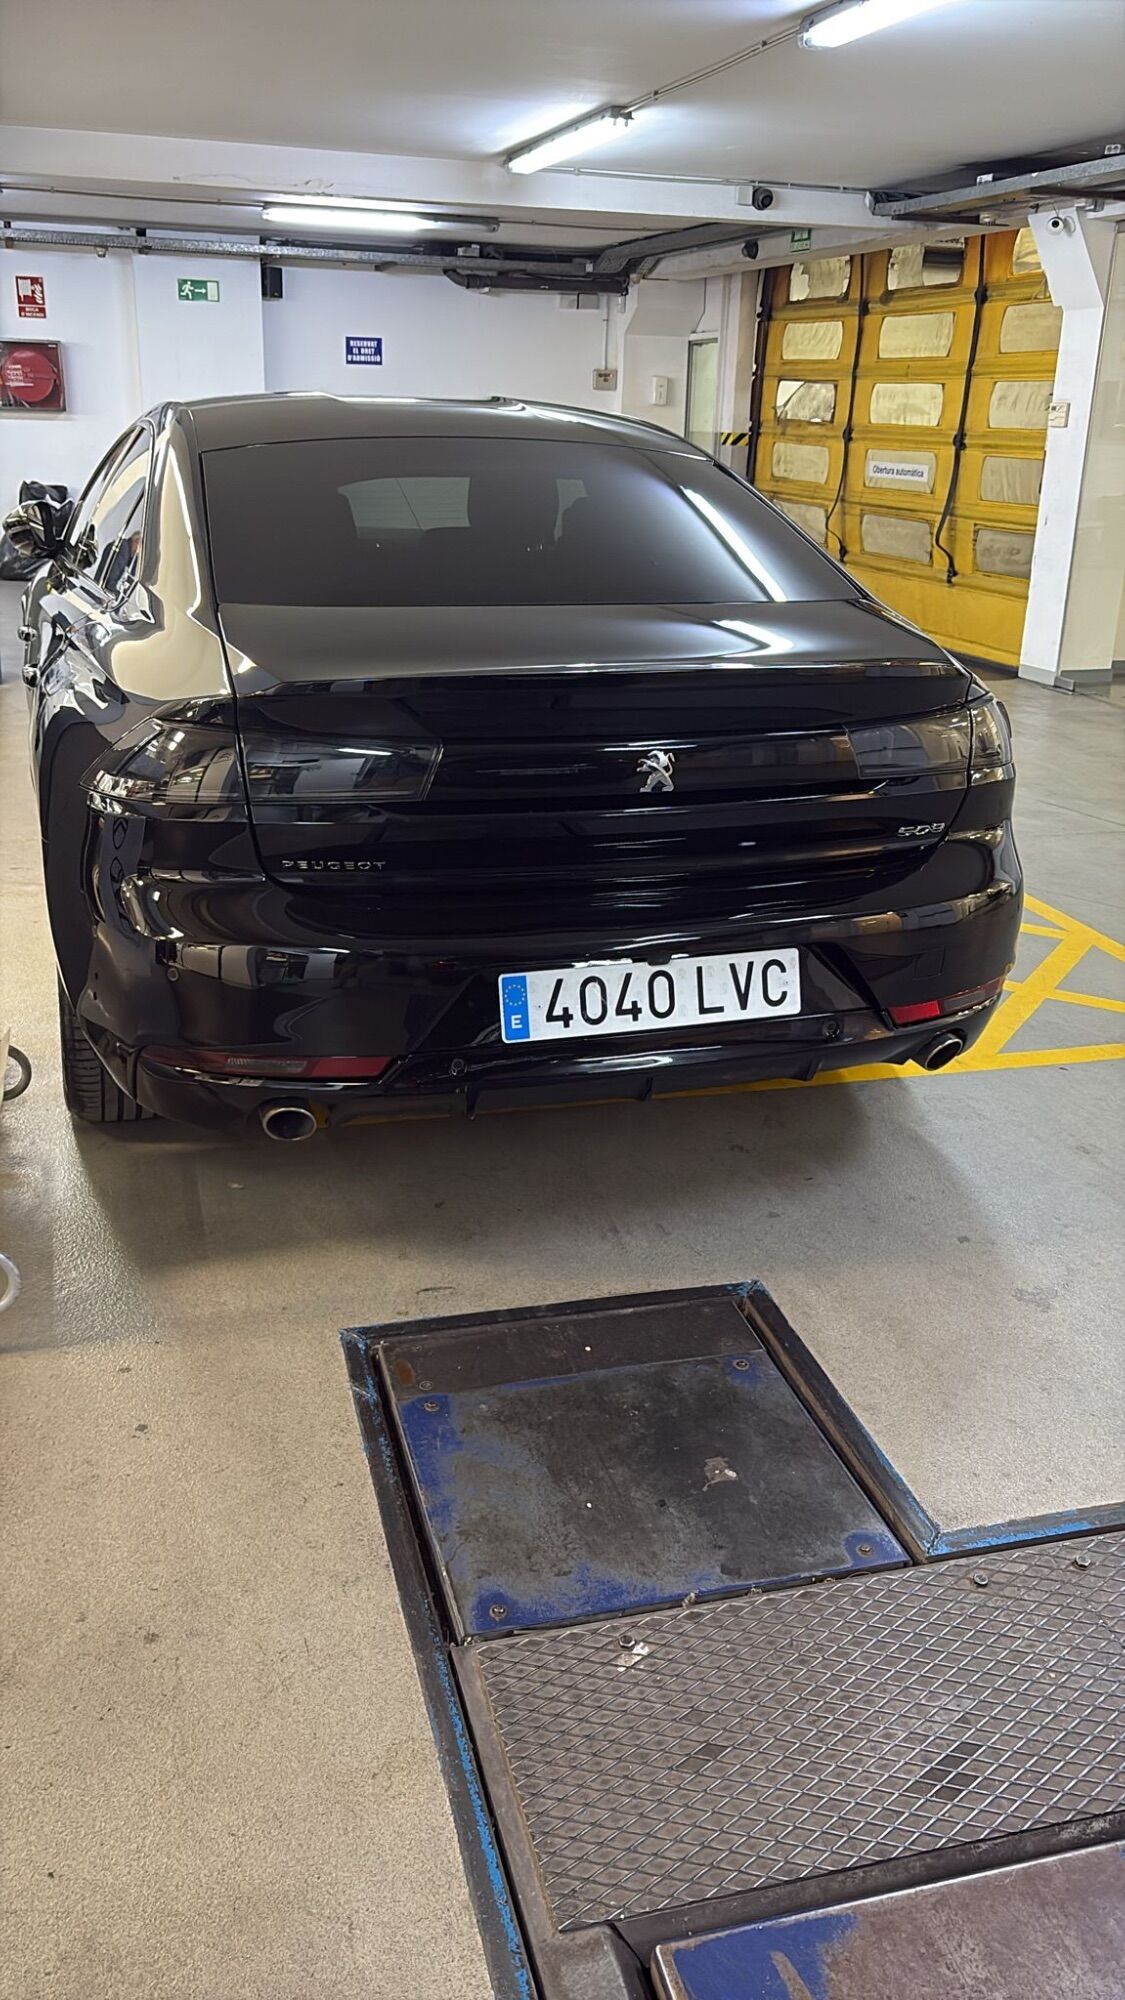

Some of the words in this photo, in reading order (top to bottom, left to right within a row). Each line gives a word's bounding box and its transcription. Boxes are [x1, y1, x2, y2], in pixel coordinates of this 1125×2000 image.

[350, 340, 378, 348] RESERVAT
[360, 347, 375, 355] DRET
[872, 464, 895, 475] Obertura
[897, 822, 946, 837] 508
[281, 860, 386, 870] PEUGEOT
[545, 969, 676, 1028] 4040
[696, 958, 788, 1015] LVC
[510, 1013, 523, 1029] E
